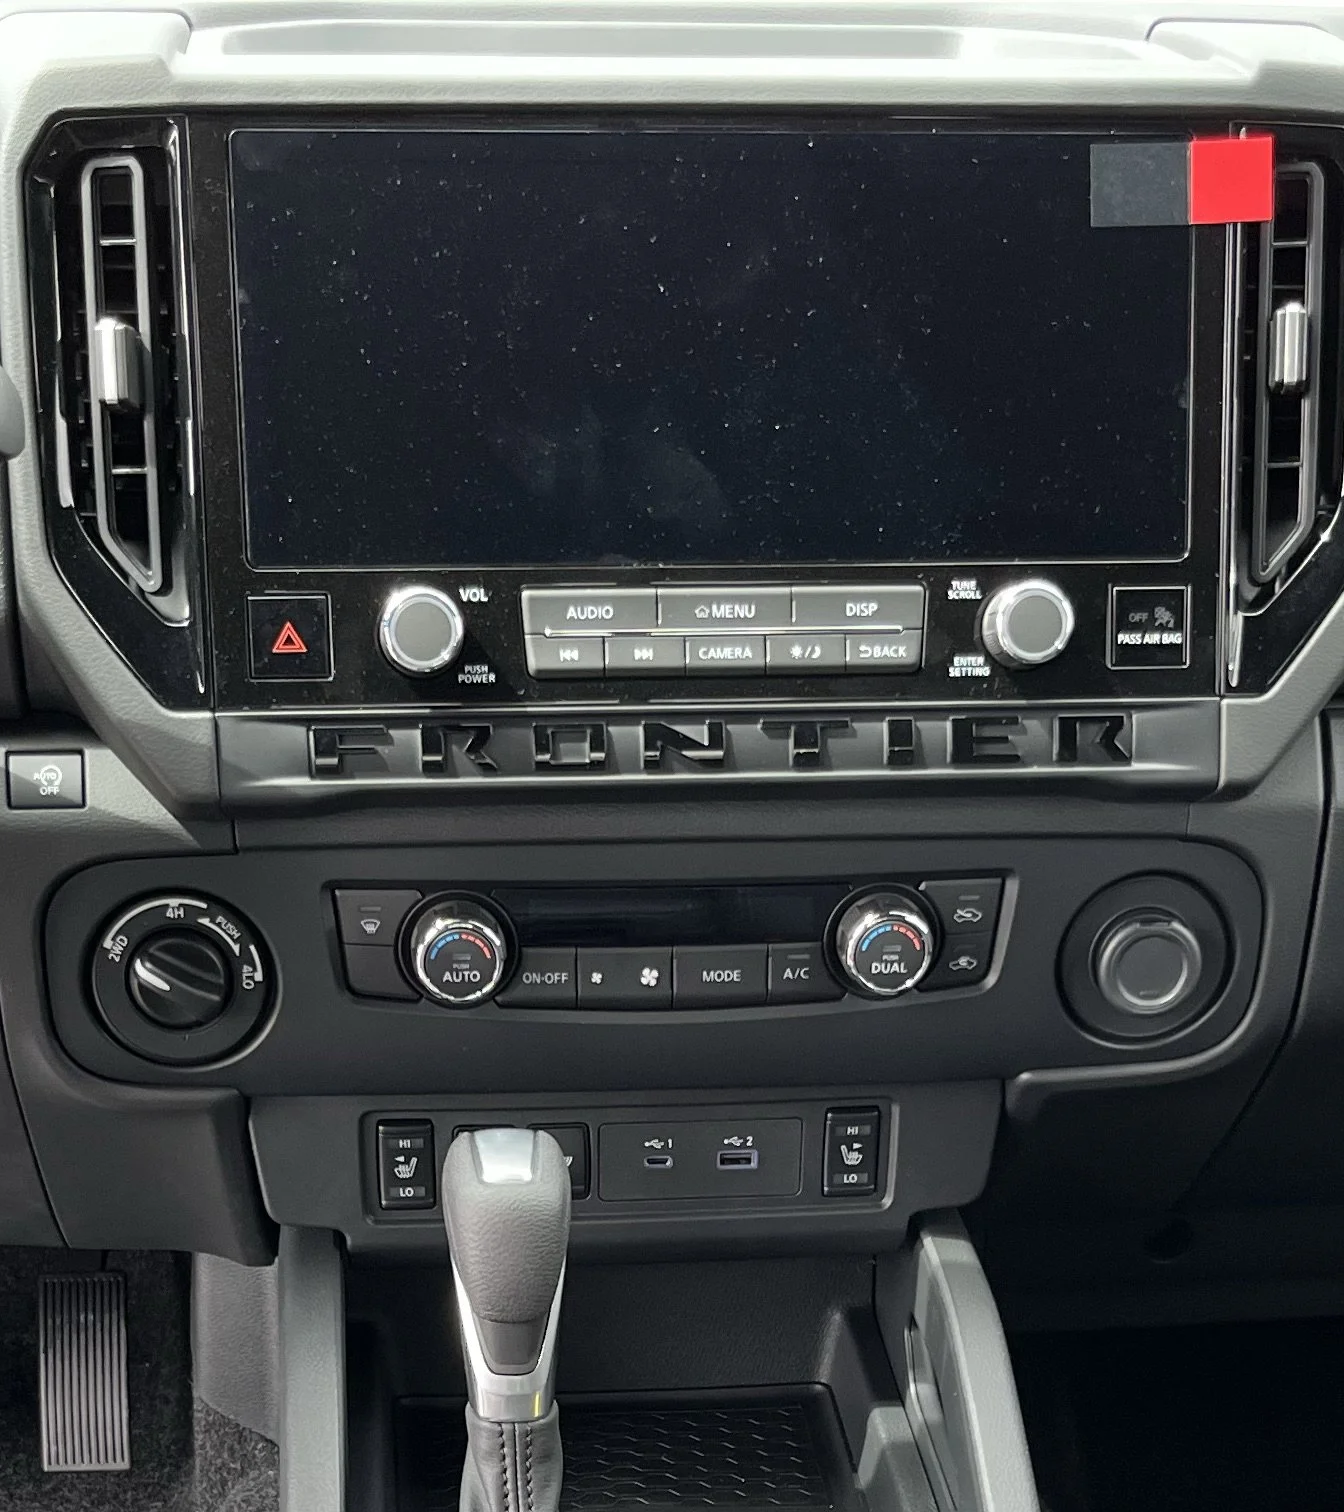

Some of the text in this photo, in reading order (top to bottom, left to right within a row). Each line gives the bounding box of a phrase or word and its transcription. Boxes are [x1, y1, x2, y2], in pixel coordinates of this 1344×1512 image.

[951, 580, 977, 591] TUNE
[458, 587, 489, 603] VOL
[947, 589, 982, 600] SCROLL
[566, 605, 614, 620] AUDIO
[711, 604, 756, 620] MENU
[845, 602, 878, 617] DISP
[1128, 612, 1149, 623] OFF
[1117, 632, 1183, 645] PASS AIR BAG
[698, 646, 753, 661] CAMERA
[873, 645, 907, 659] BACK
[953, 656, 985, 667] ENTER
[464, 664, 489, 674] PUSH
[948, 666, 991, 677] SETTING
[458, 672, 497, 684] POWER
[308, 715, 1134, 779] FRONTIER
[39, 785, 60, 796] OFF
[165, 907, 185, 919] 4H
[215, 915, 241, 940] PUSH
[108, 935, 129, 963] 2WD
[783, 967, 810, 980] A/C
[871, 962, 908, 974] DUAL
[242, 964, 255, 990] 4LO
[442, 970, 481, 983] AUTO
[702, 970, 741, 983] MODE
[846, 1126, 859, 1135] HI
[399, 1140, 411, 1149] HI
[667, 1138, 673, 1149] 1
[746, 1136, 753, 1147] 2
[843, 1174, 858, 1183] LO
[399, 1188, 414, 1197] LO
